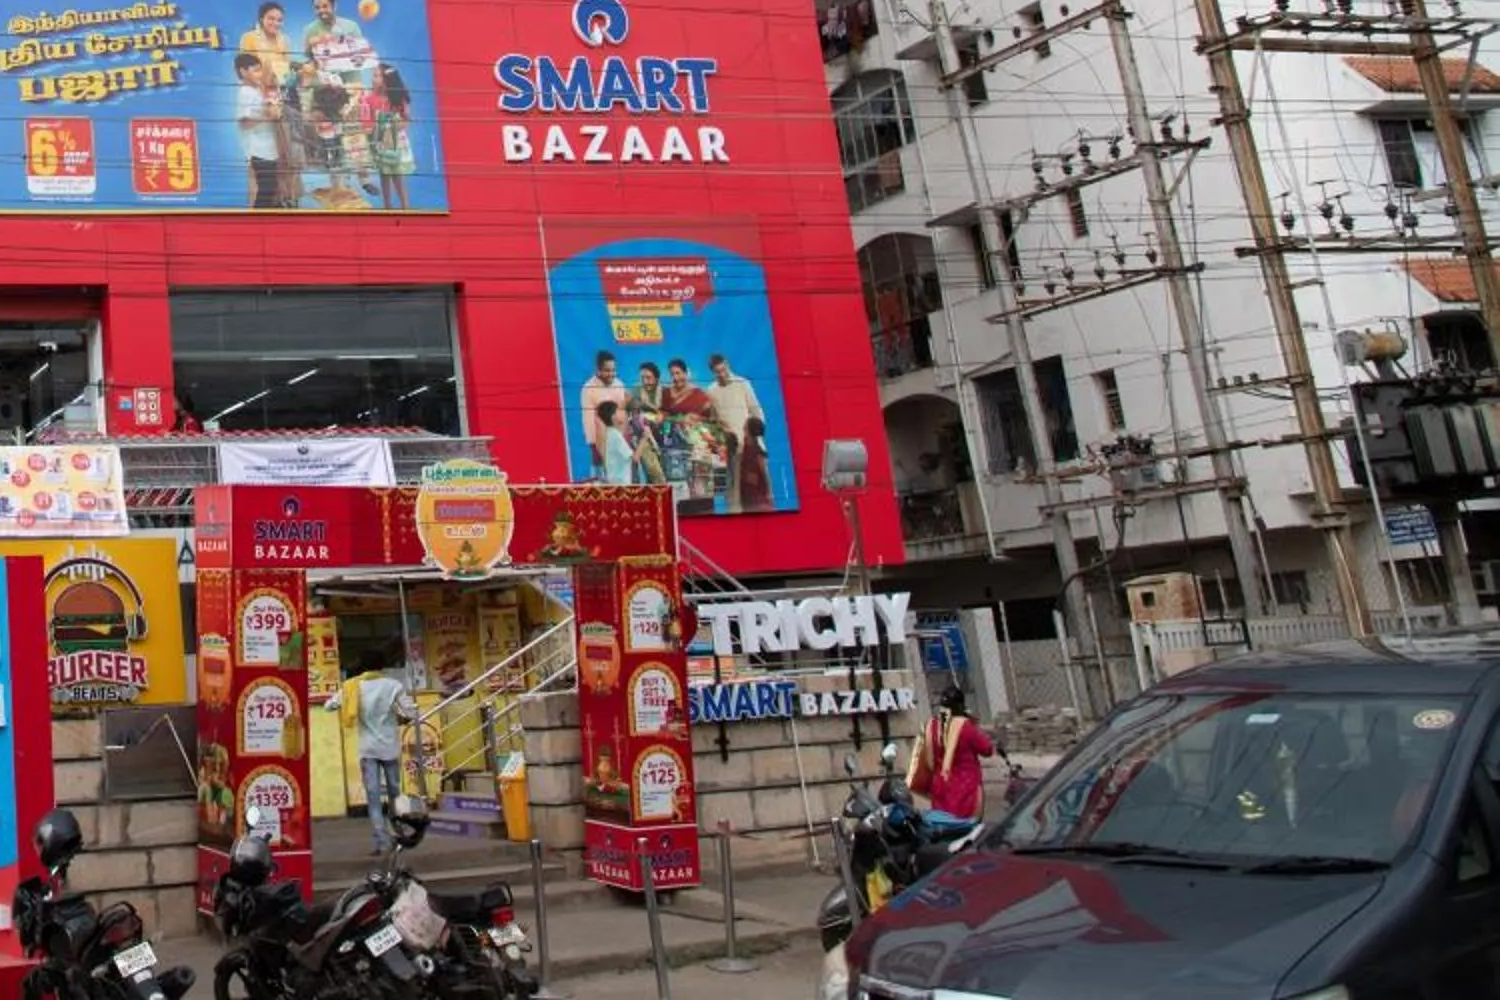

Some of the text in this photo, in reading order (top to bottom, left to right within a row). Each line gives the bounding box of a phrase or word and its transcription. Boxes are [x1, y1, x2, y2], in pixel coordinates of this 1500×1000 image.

[494, 54, 717, 114] SMART
[501, 124, 730, 162] BAZAAR
[255, 520, 326, 541] SMART
[255, 545, 329, 560] BAZAAR
[698, 592, 911, 655] TRICHY
[48, 651, 147, 686] BURGER
[688, 682, 795, 722] SMART
[801, 688, 916, 716] BAZAAR
[652, 867, 693, 879] AZAAR
